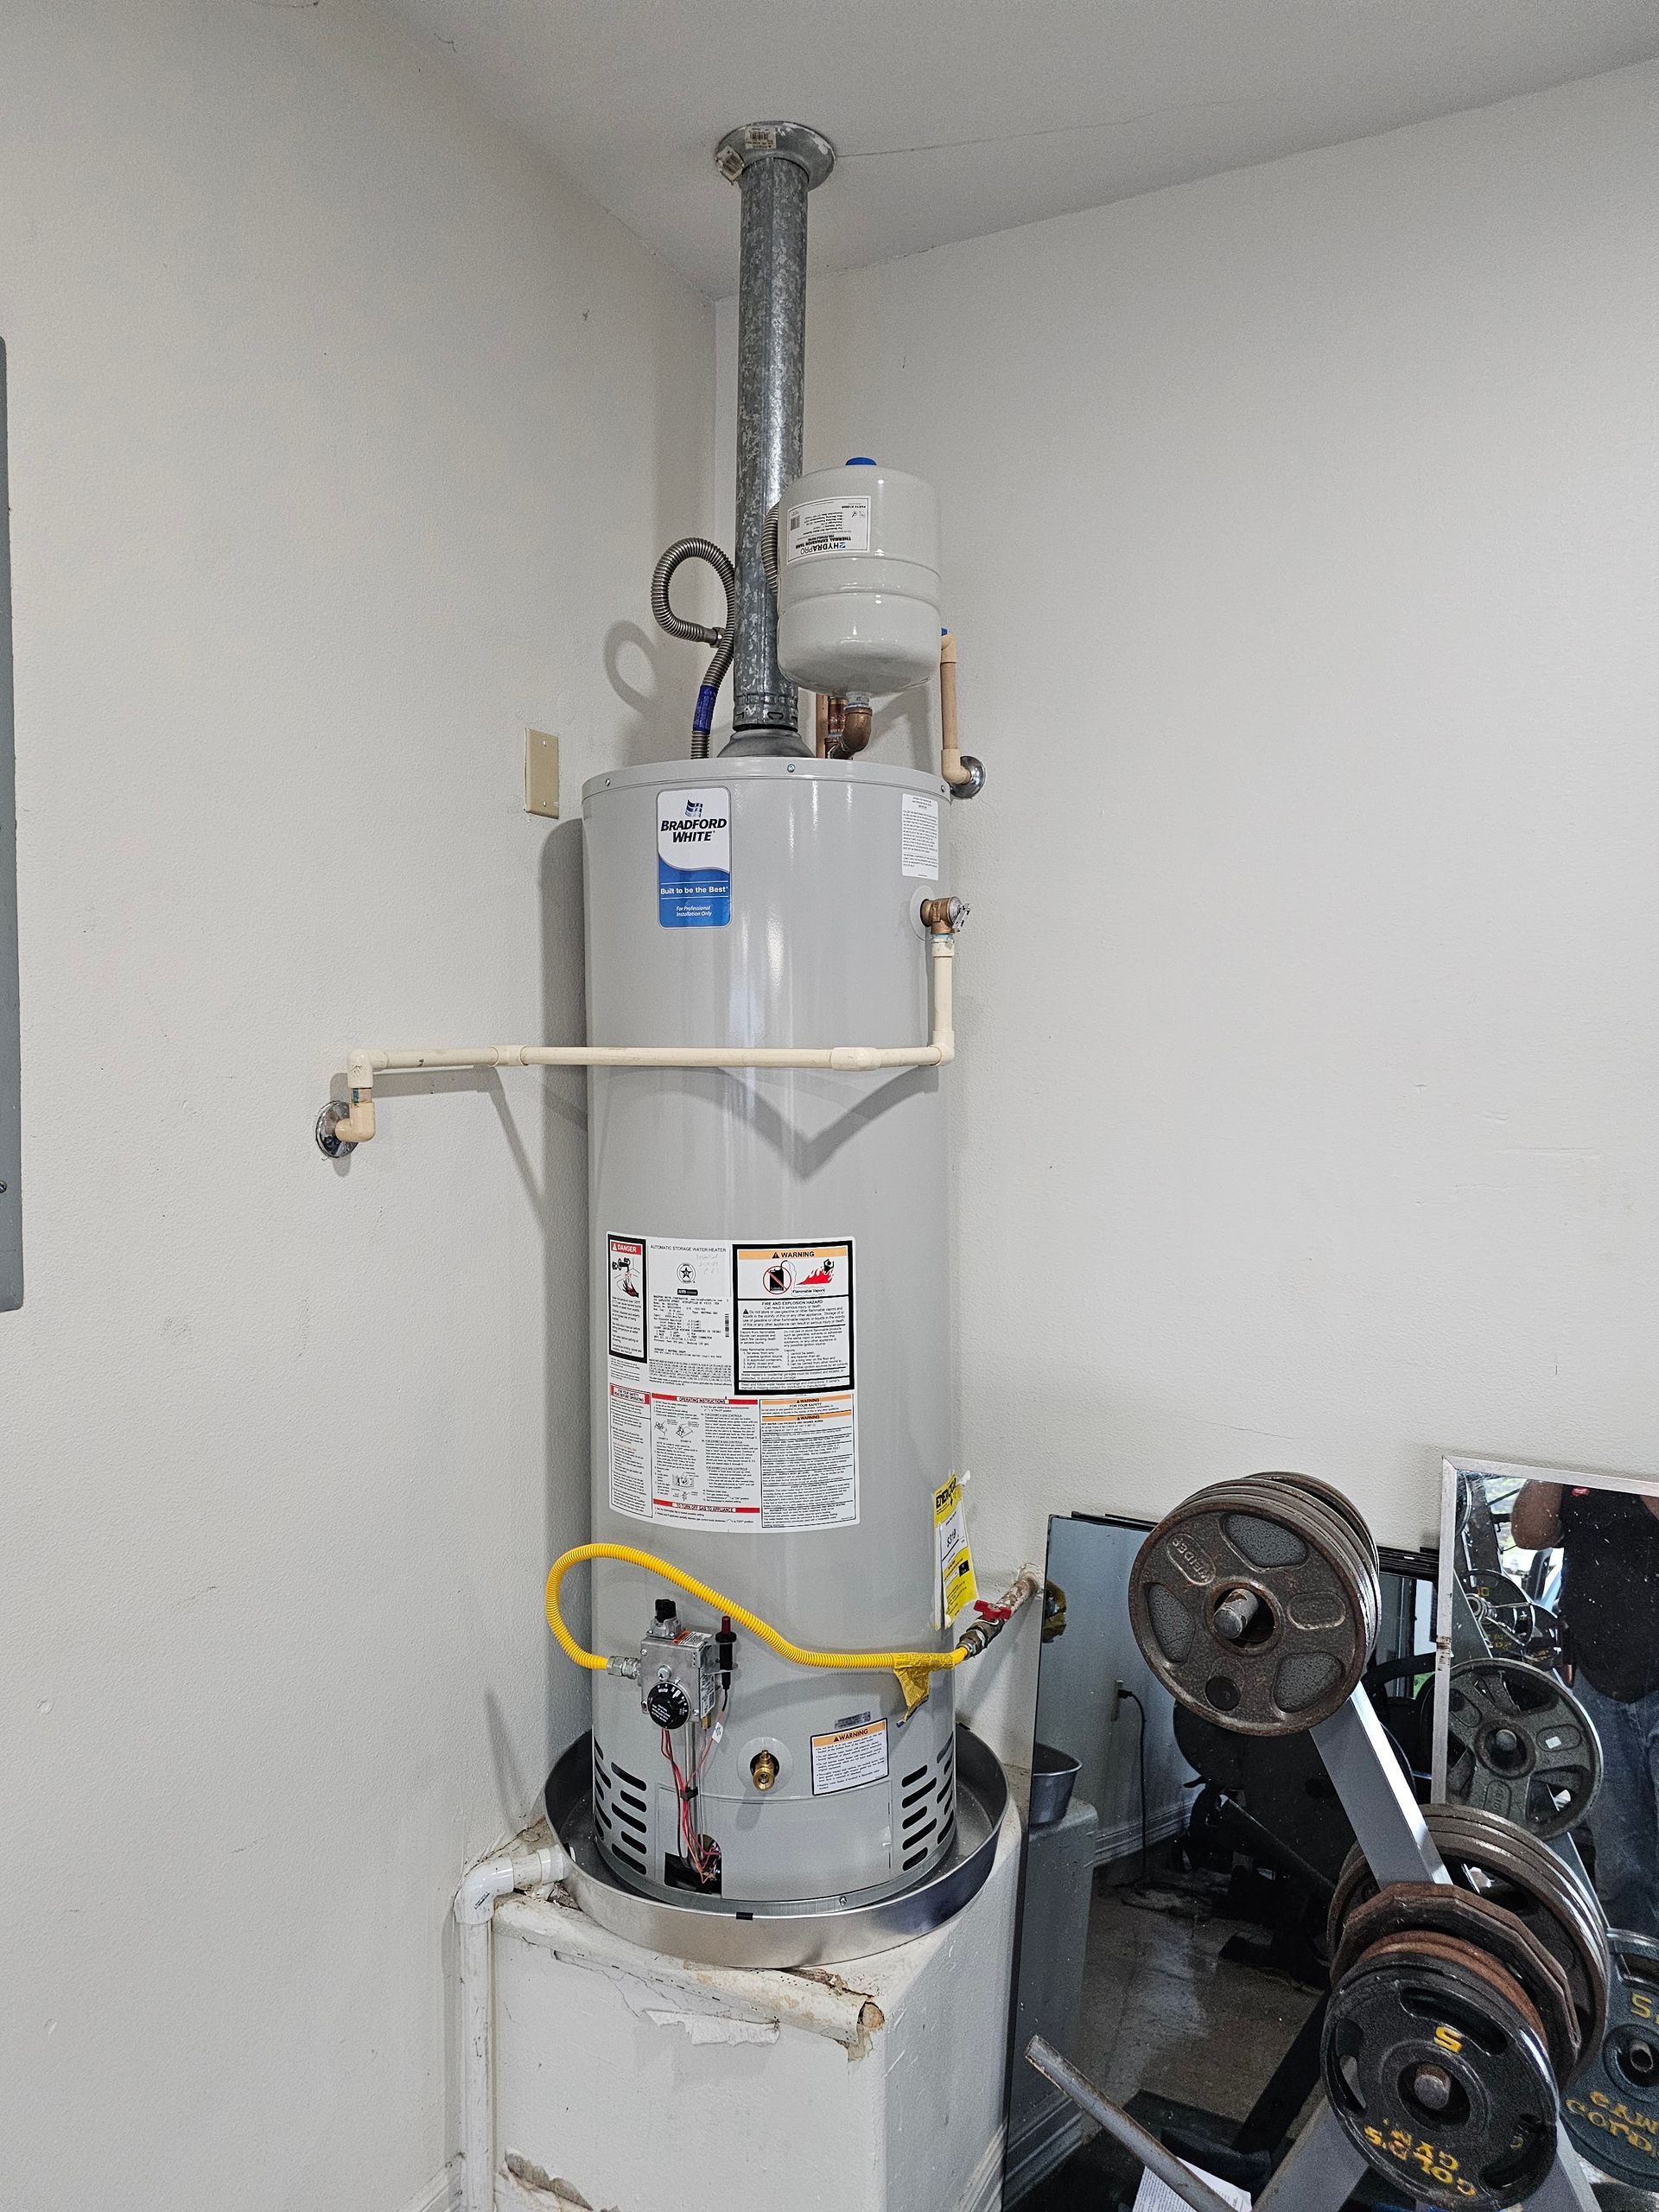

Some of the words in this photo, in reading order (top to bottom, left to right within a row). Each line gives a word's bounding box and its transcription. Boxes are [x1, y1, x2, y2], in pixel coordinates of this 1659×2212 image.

[800, 542, 839, 555] HYDRAPRO
[660, 818, 728, 831] BRADFORD
[672, 831, 712, 842] WHITE
[617, 1244, 637, 1253] DANGER
[838, 1728, 868, 1741] WARNING
[1433, 2026, 1463, 2053] 5
[1364, 2126, 1477, 2196] GOLD'S
